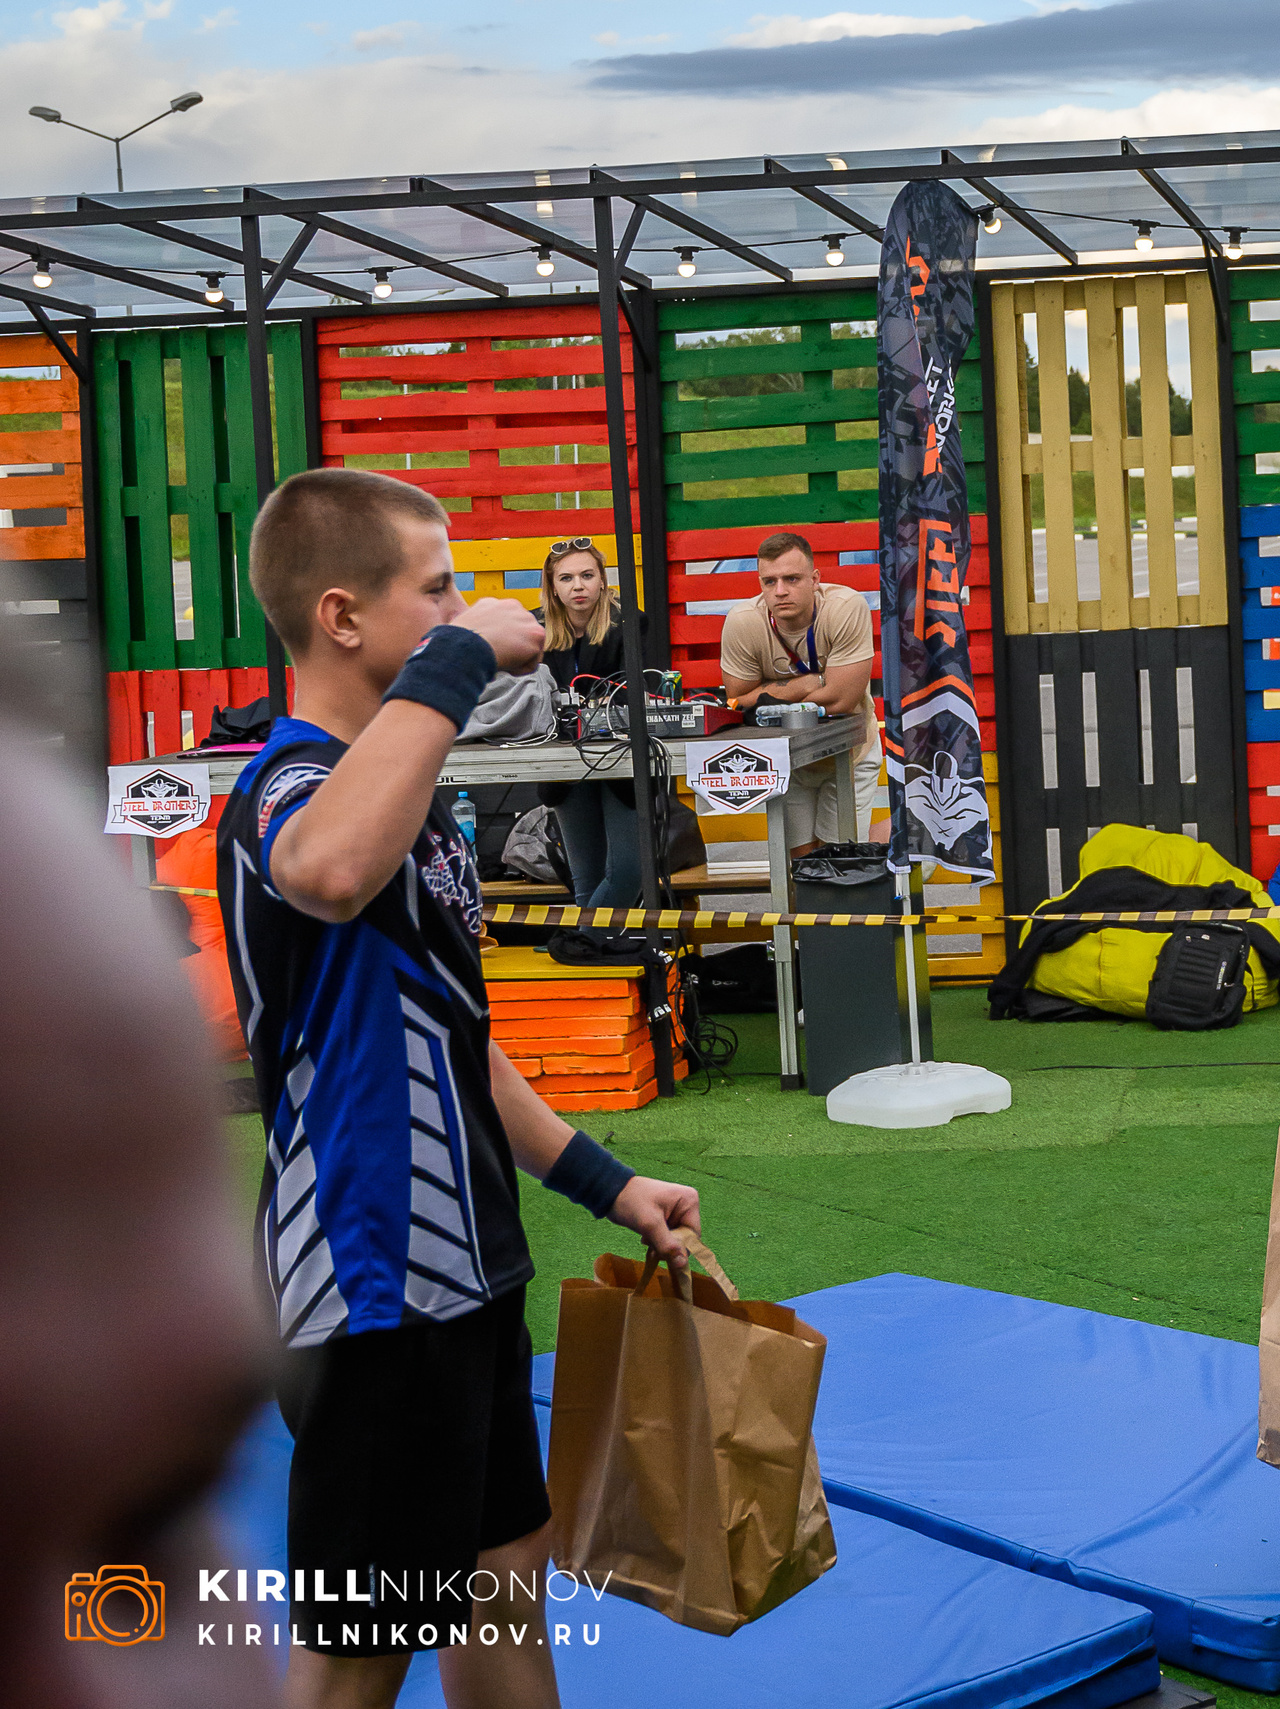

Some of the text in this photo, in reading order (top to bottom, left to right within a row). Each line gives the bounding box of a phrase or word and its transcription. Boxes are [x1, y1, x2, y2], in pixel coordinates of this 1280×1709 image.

[701, 774, 777, 788] STEEL BROTHERS
[123, 799, 198, 812] STEEL BROTHERS
